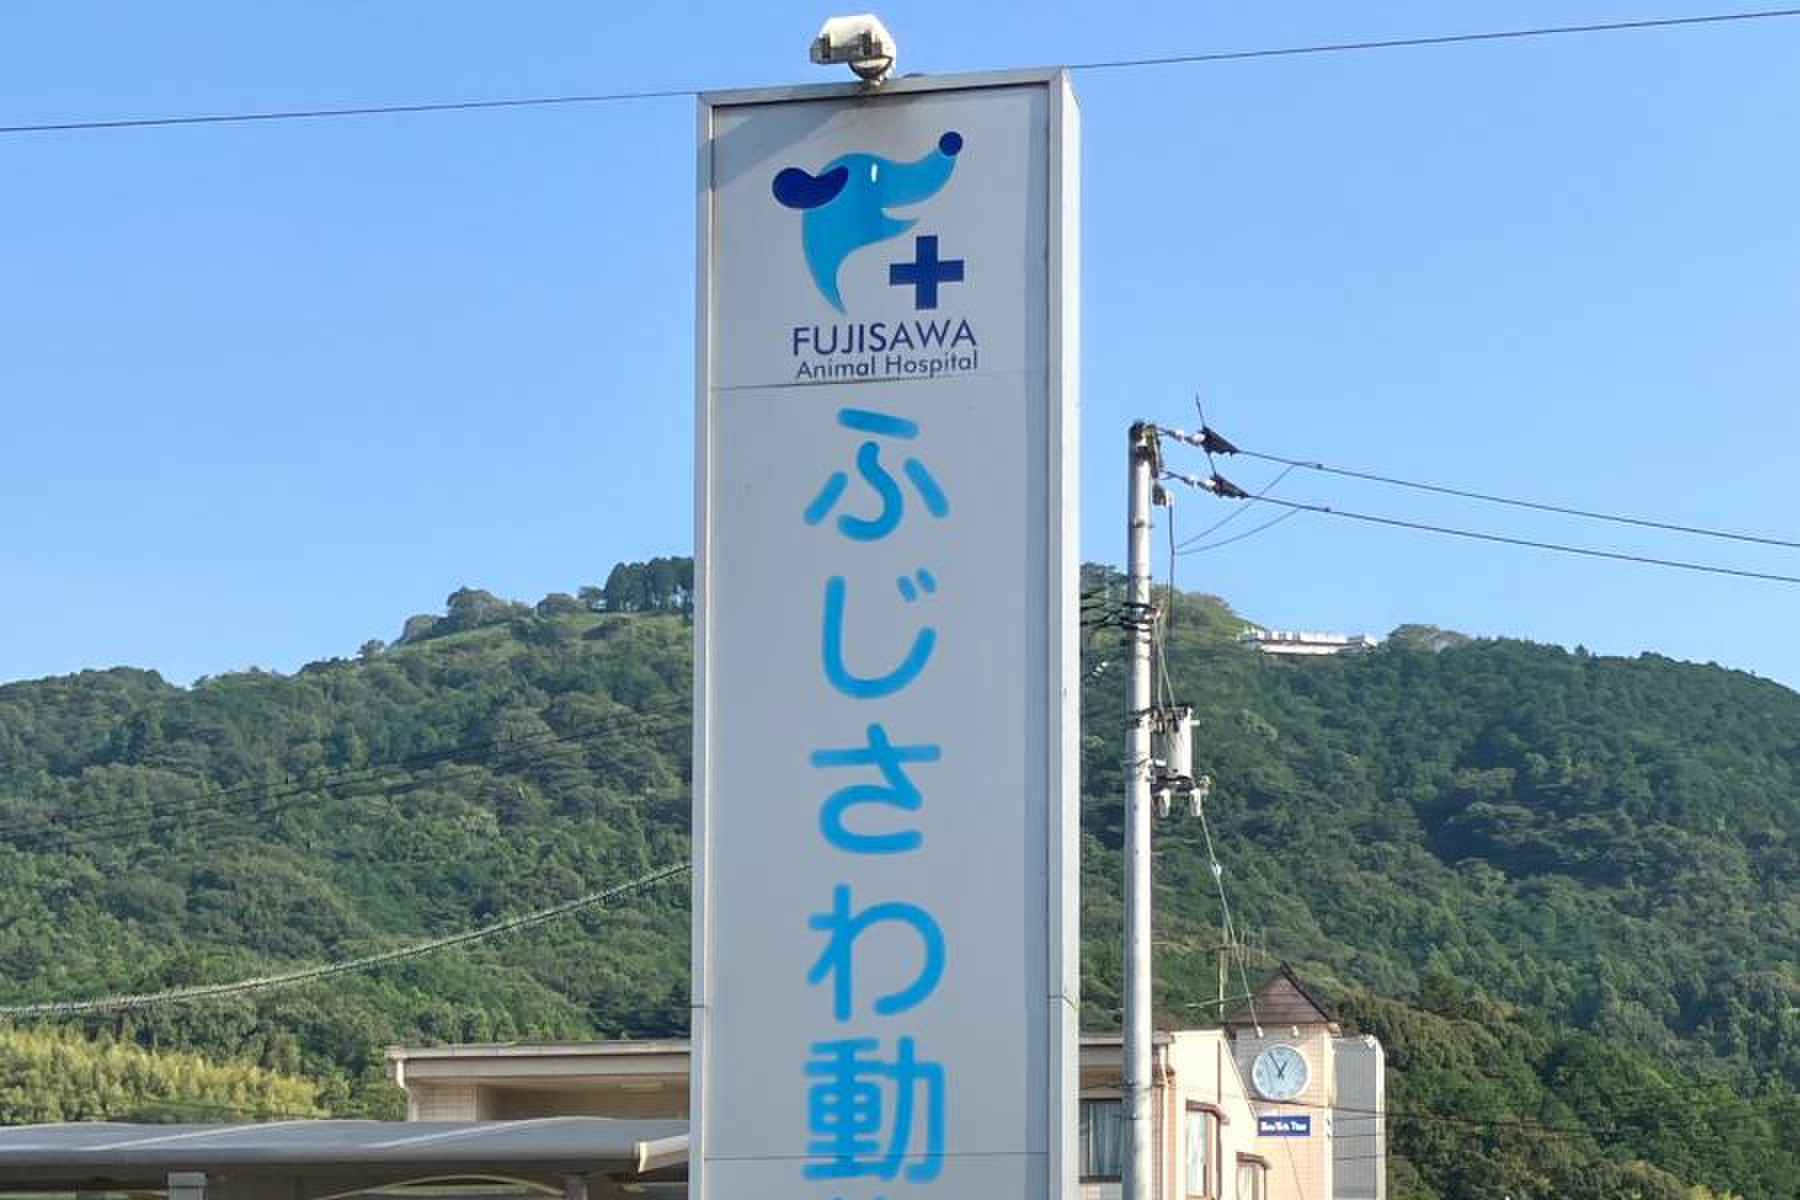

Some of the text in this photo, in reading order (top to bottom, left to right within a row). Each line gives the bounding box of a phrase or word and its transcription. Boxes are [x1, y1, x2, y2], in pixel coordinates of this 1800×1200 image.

[793, 319, 977, 356] FUJISAWA
[796, 349, 979, 380] Animal Hospital
